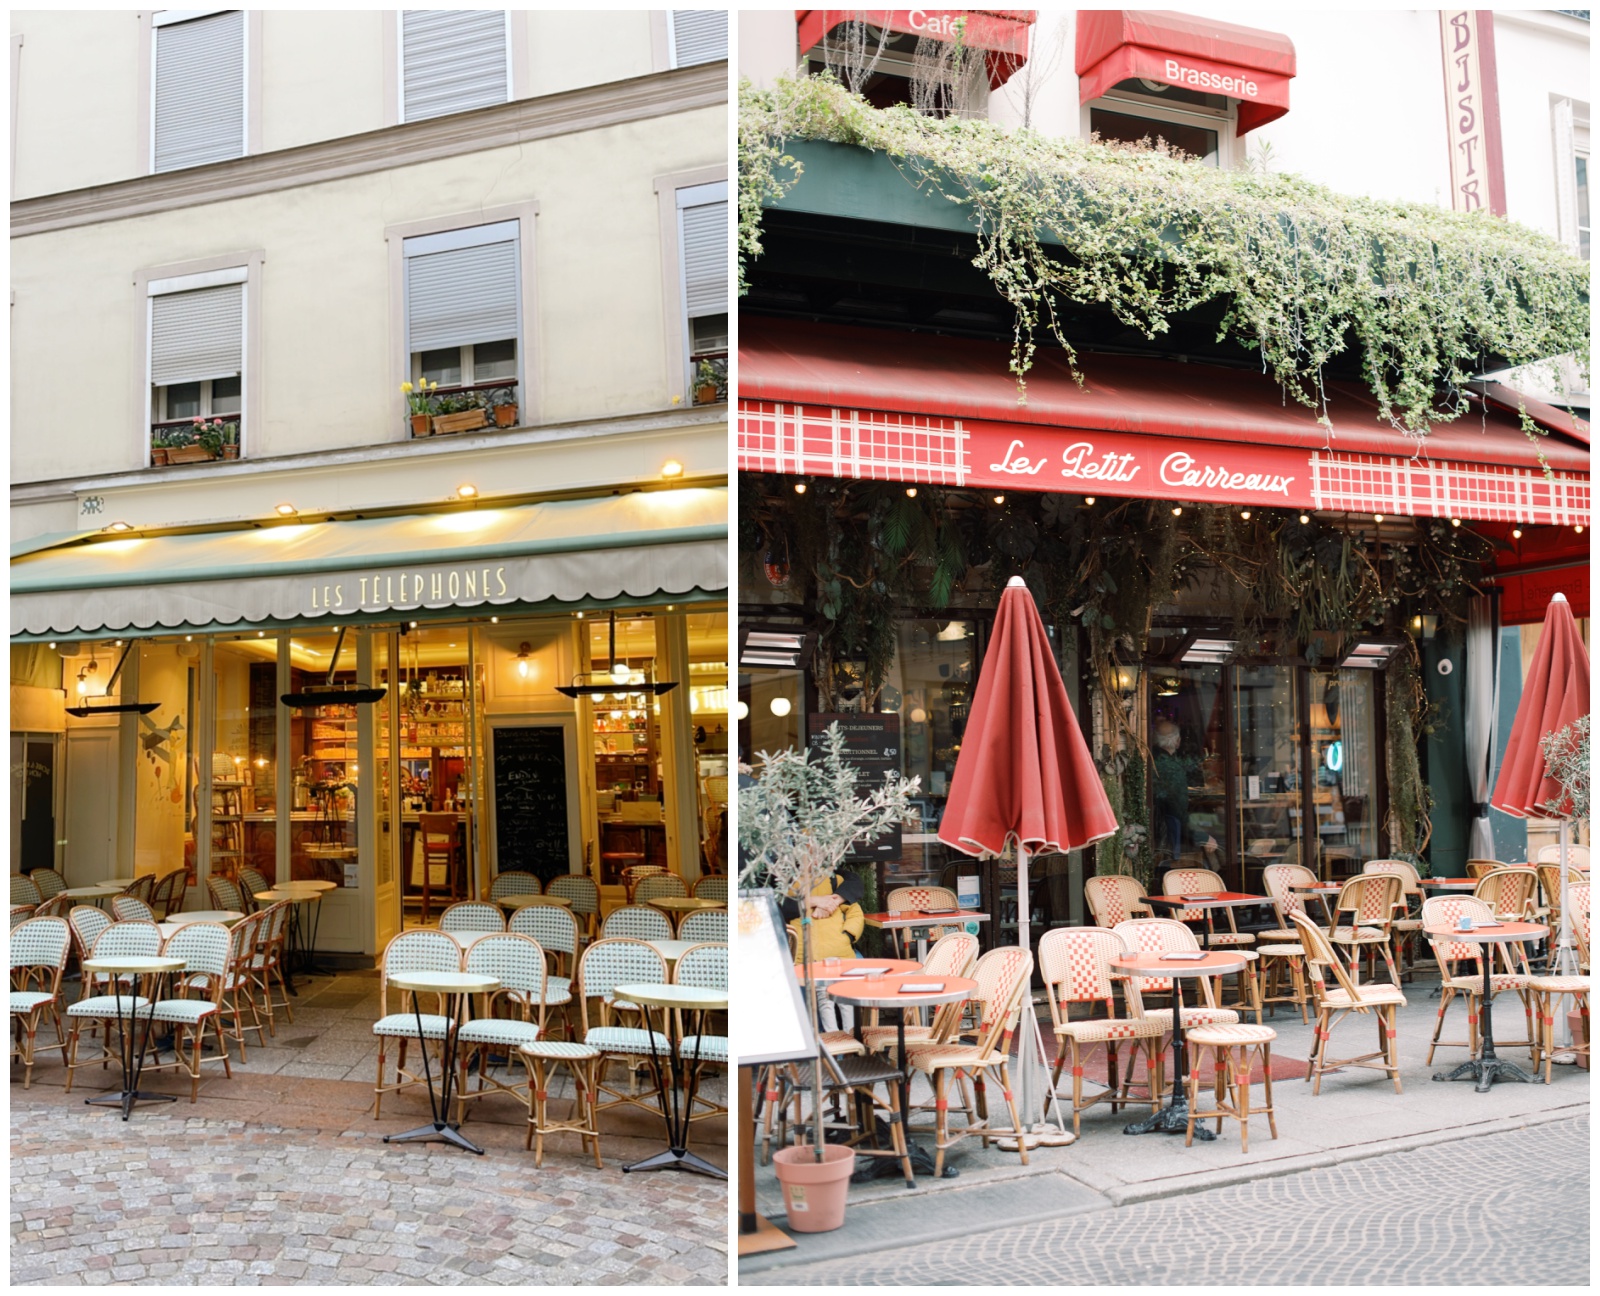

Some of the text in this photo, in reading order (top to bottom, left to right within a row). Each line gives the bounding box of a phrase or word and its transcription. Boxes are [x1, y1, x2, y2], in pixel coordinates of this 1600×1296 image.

[1165, 59, 1258, 97] Brasserie
[990, 439, 1295, 496] Les Petits Carreaux
[312, 585, 343, 608] LES
